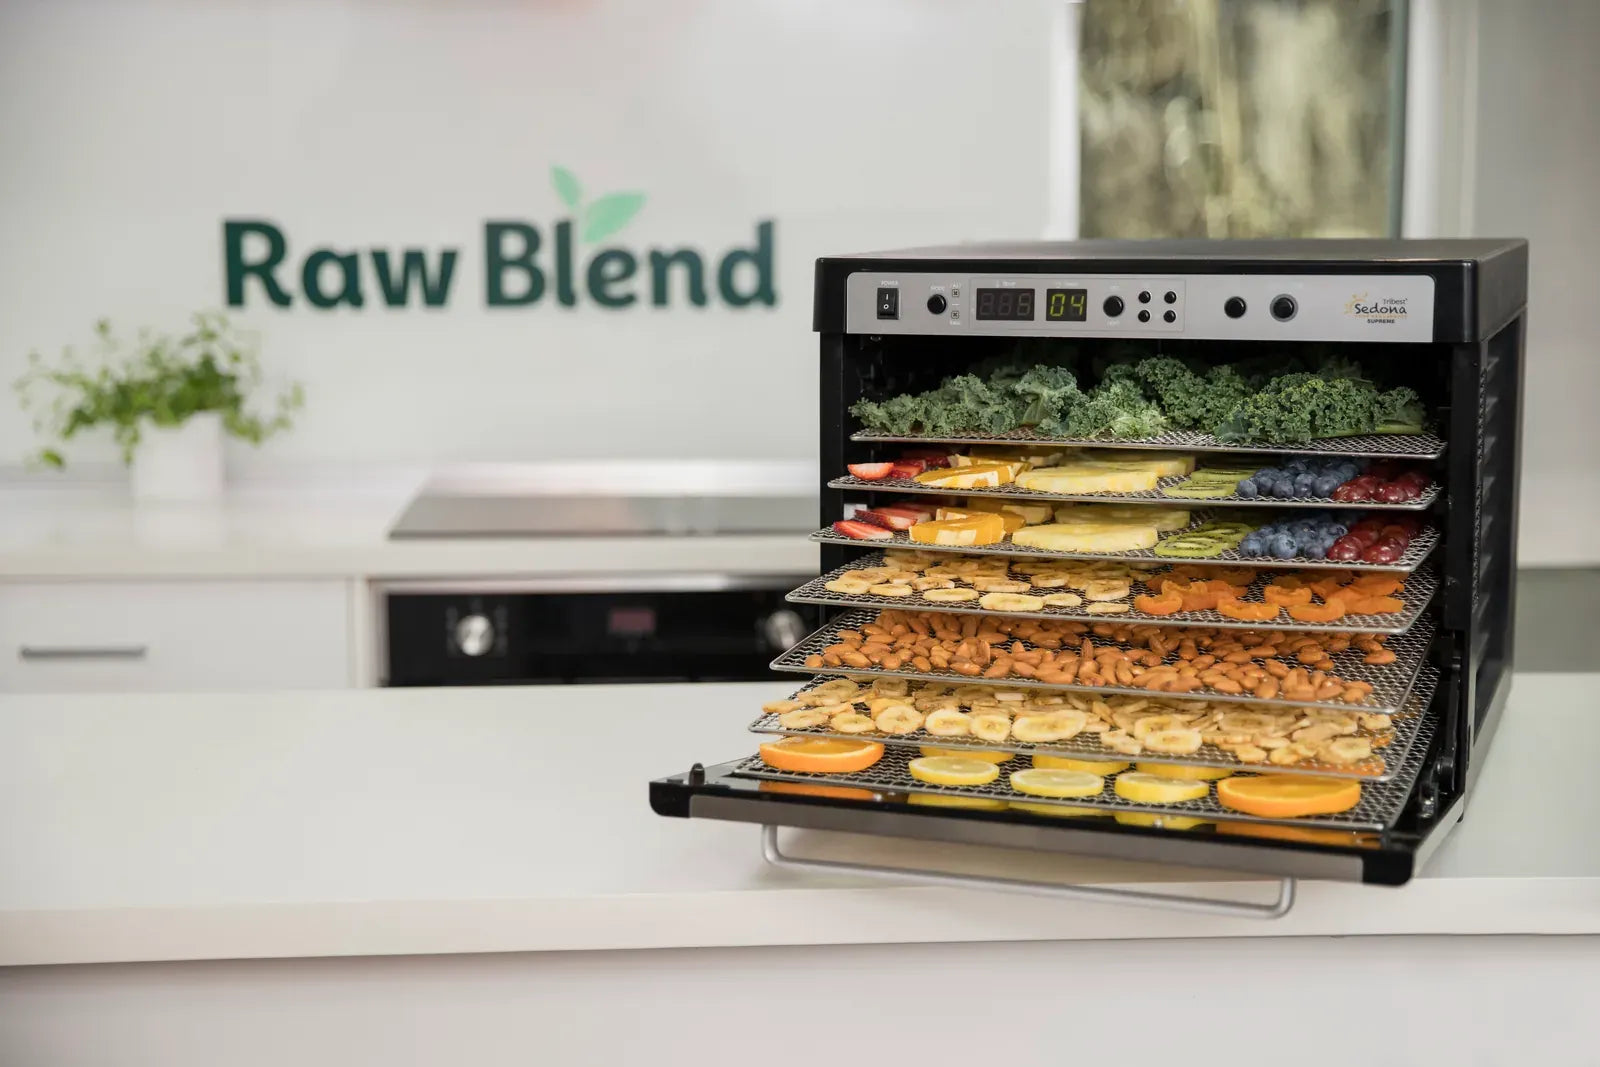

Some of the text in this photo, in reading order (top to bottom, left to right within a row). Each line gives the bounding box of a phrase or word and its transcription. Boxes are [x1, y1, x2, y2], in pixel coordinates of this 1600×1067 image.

[221, 218, 779, 310] Raw Blend
[1049, 293, 1085, 317] 04
[1354, 302, 1407, 314] Sedona
